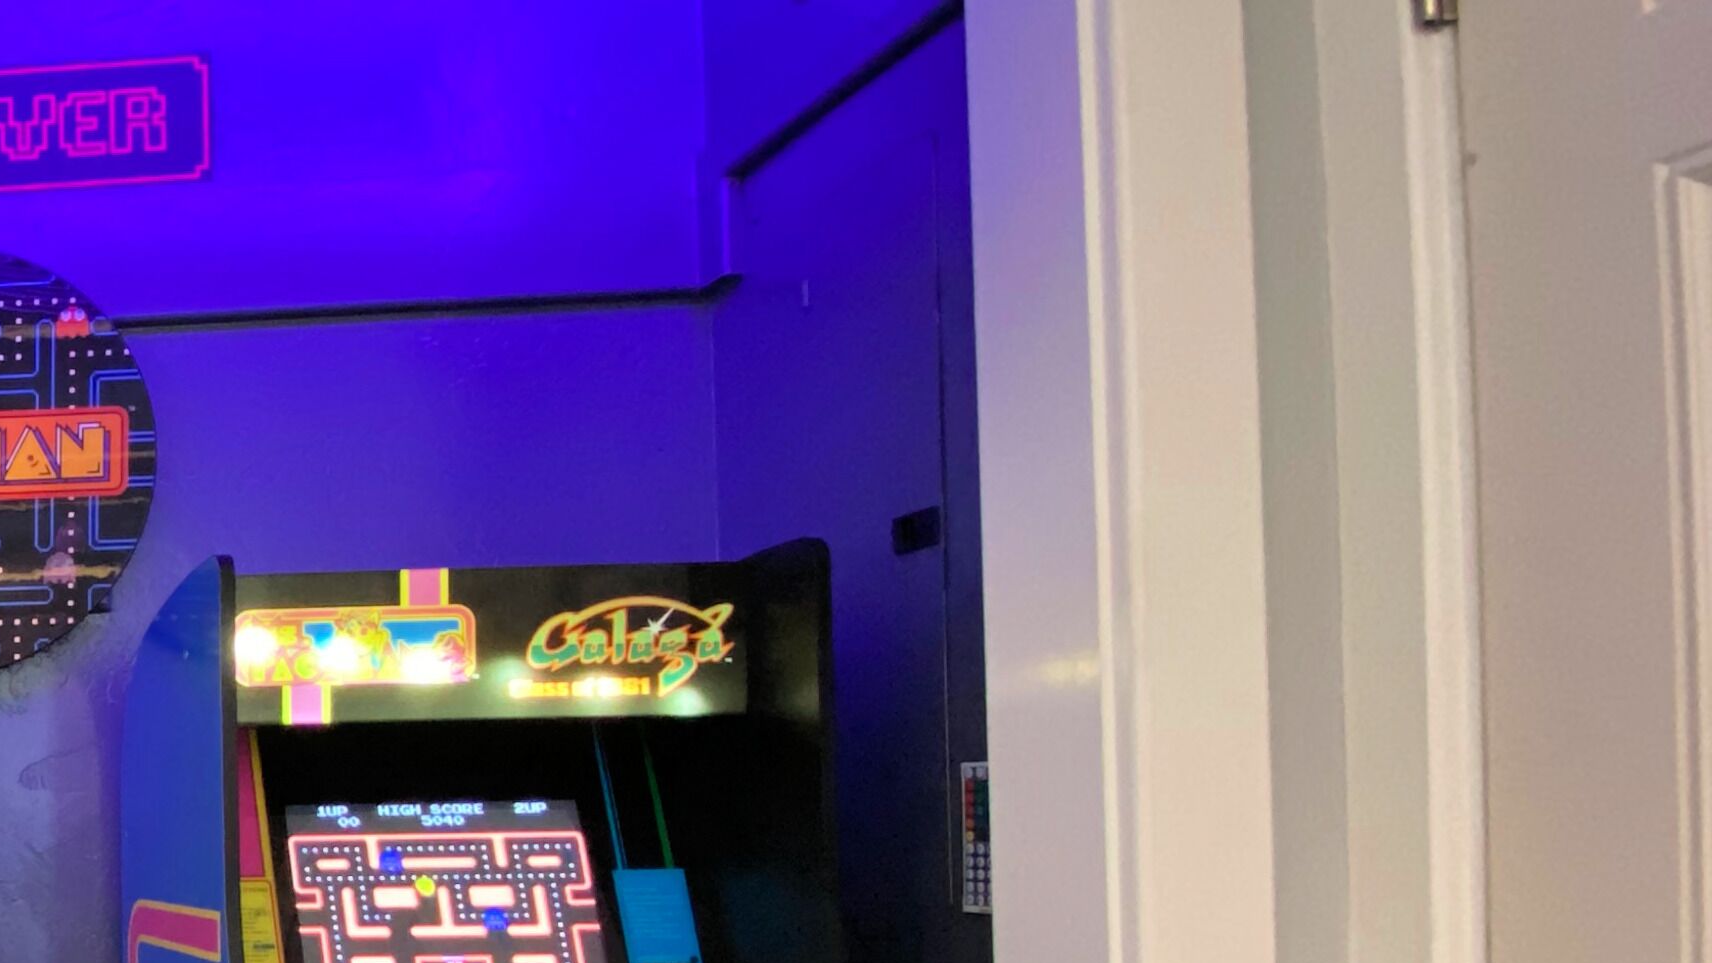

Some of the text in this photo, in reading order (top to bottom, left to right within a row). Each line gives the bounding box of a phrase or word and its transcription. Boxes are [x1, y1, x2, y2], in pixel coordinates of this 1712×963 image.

[526, 596, 736, 698] Galaga
[317, 805, 348, 818] 1UP
[377, 803, 484, 817] HIGH SCORE
[513, 801, 547, 814] 2UP
[337, 816, 361, 828] 00
[420, 815, 465, 827] 5040
